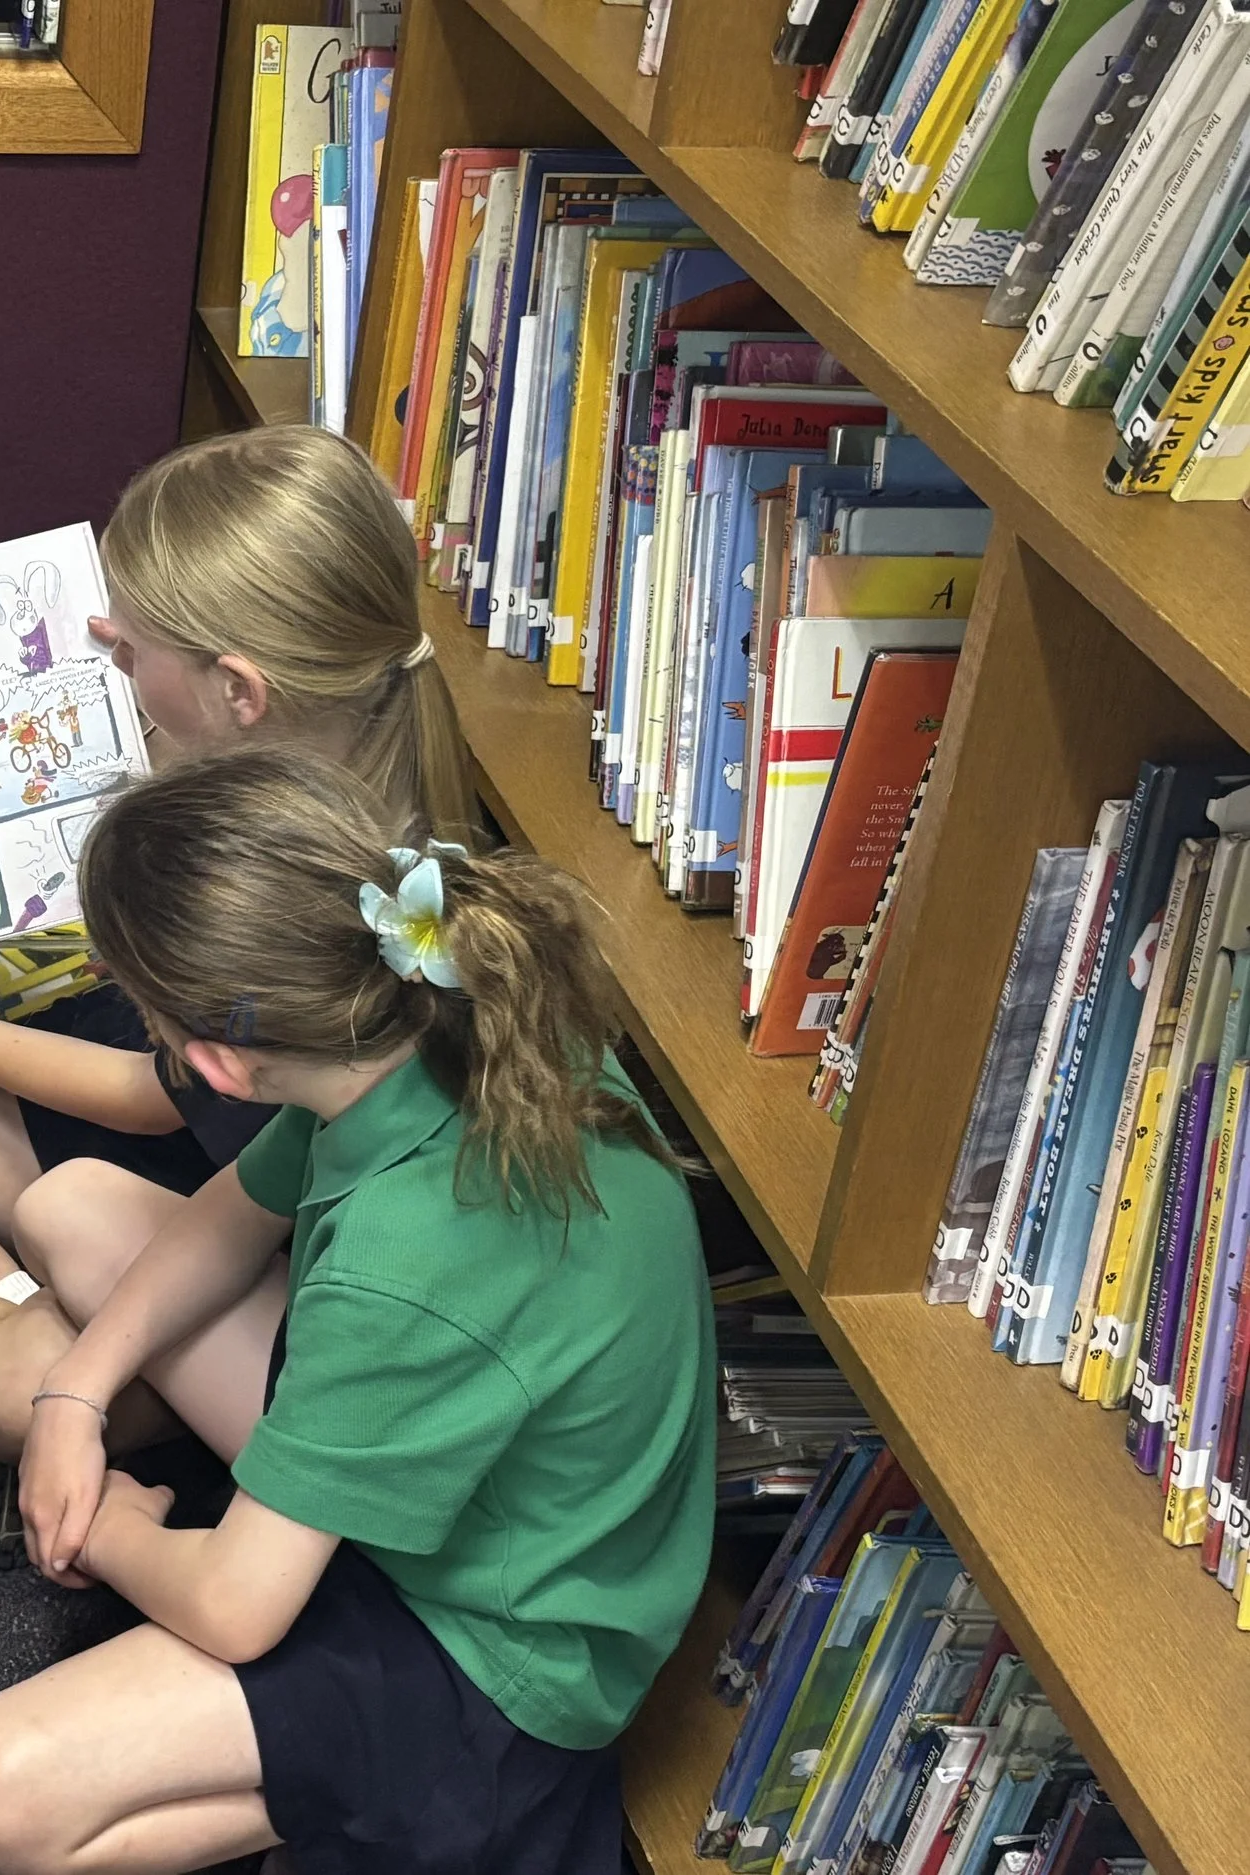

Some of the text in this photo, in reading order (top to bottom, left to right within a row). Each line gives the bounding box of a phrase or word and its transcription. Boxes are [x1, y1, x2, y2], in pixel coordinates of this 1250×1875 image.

[940, 0, 975, 55] GREGG
[1070, 22, 1214, 267] Carle The Very Quiet Cricket
[1195, 139, 1205, 148] a
[1200, 112, 1222, 142] Does
[936, 136, 973, 193] SADAK
[1166, 146, 1203, 197] Kangaroo
[1149, 220, 1159, 230] a
[1153, 194, 1176, 223] Have
[1127, 228, 1156, 268] Mother,
[1116, 265, 1136, 291] Too?
[737, 414, 782, 439] Julia
[1140, 356, 1226, 484] smart kids
[745, 651, 757, 689] WORK
[876, 785, 899, 796] The
[1127, 779, 1148, 821] POLLY
[860, 828, 875, 839] So
[865, 814, 885, 825] the
[850, 856, 882, 868] fall in
[856, 842, 885, 853] when
[1114, 823, 1138, 878] DUNBAR
[1075, 868, 1093, 901] THE
[1168, 877, 1187, 909] Tomie
[997, 891, 1037, 1006] ANISA'S ALPHABET
[1061, 904, 1083, 953] PAPER
[1047, 957, 1069, 1008] DOLLS
[1075, 901, 1117, 1042] ARTHUR'S
[1143, 887, 1217, 1183] MOON BEAR RESCUE Kim Dale
[1020, 1087, 1034, 1112] Julia
[1052, 1045, 1083, 1139] DREAM
[1113, 1050, 1145, 1152] The Magic Pasta Pot
[1006, 1111, 1028, 1161] Donaldson
[1034, 1142, 1060, 1216] BOAT
[1143, 1103, 1187, 1341] HAIRY MACLARY'S HAT TRICKS LYNLEY DODD
[1147, 1093, 1199, 1376] SLINKY EARLY BIRD LYNLEY DODD
[1183, 1086, 1237, 1402] DAHL LOZANO THE WORST SLEEPOVER IN THE WORLD
[899, 1744, 943, 1818] Ferrell Santoso
